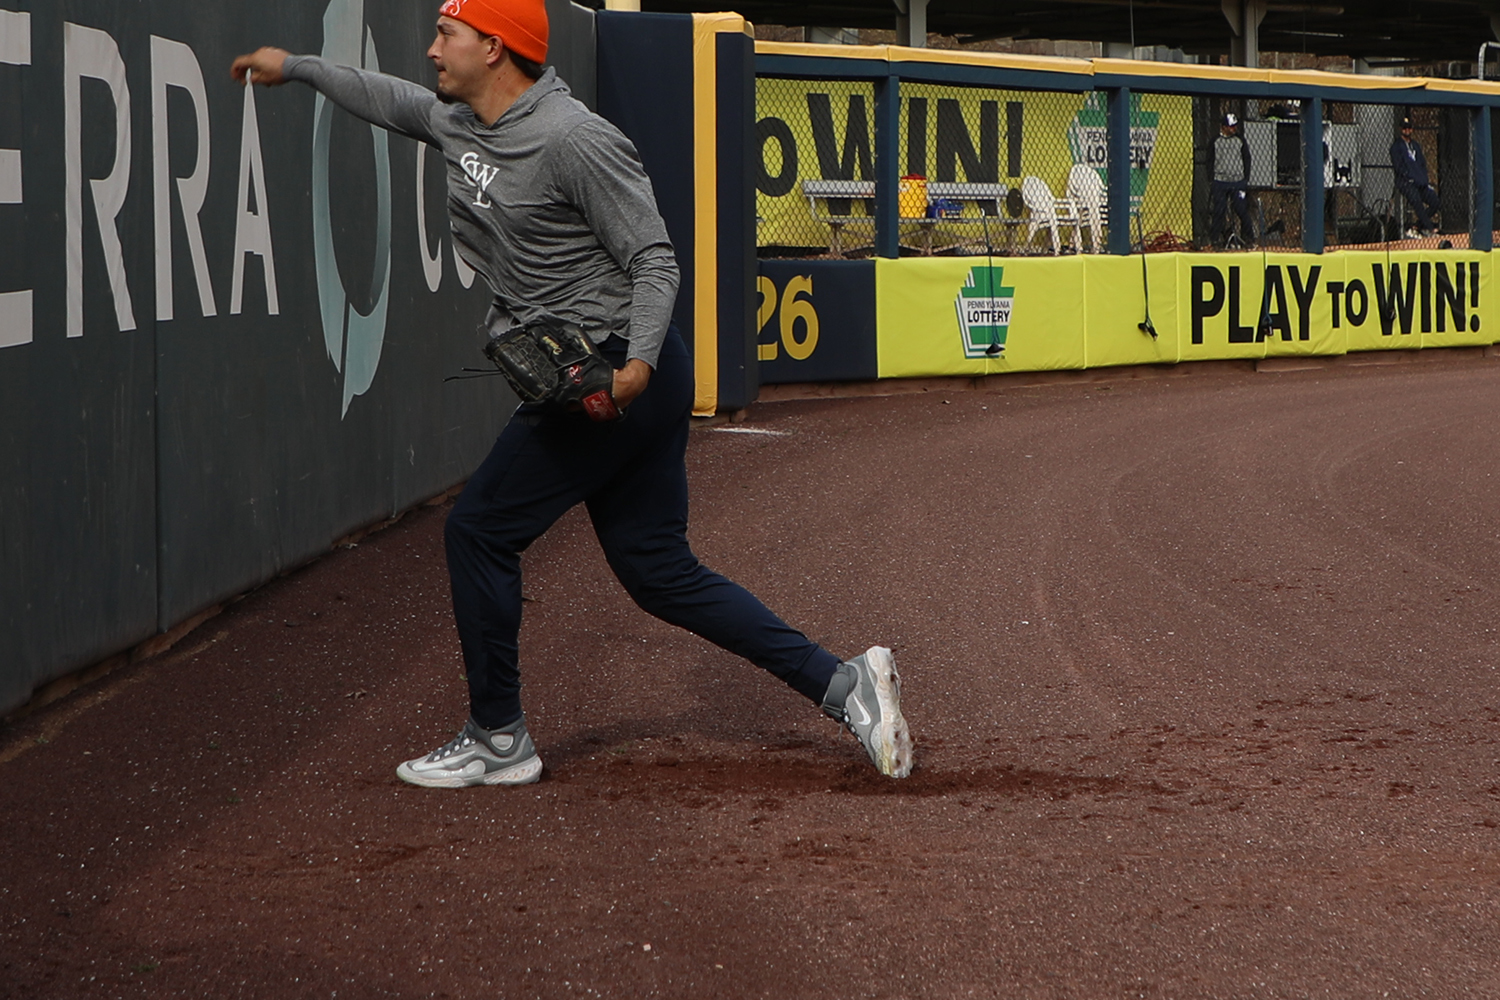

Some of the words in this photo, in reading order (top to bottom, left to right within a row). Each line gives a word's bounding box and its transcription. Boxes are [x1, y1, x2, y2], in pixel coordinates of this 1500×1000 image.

[755, 116, 798, 197] O
[807, 92, 1024, 218] WIN!
[1087, 145, 1152, 163] LORY
[967, 301, 1010, 309] PENNSYLVANIA
[1191, 265, 1322, 344] PLAY
[1372, 261, 1480, 336] WIN!
[967, 310, 1010, 323] LOTTERY
